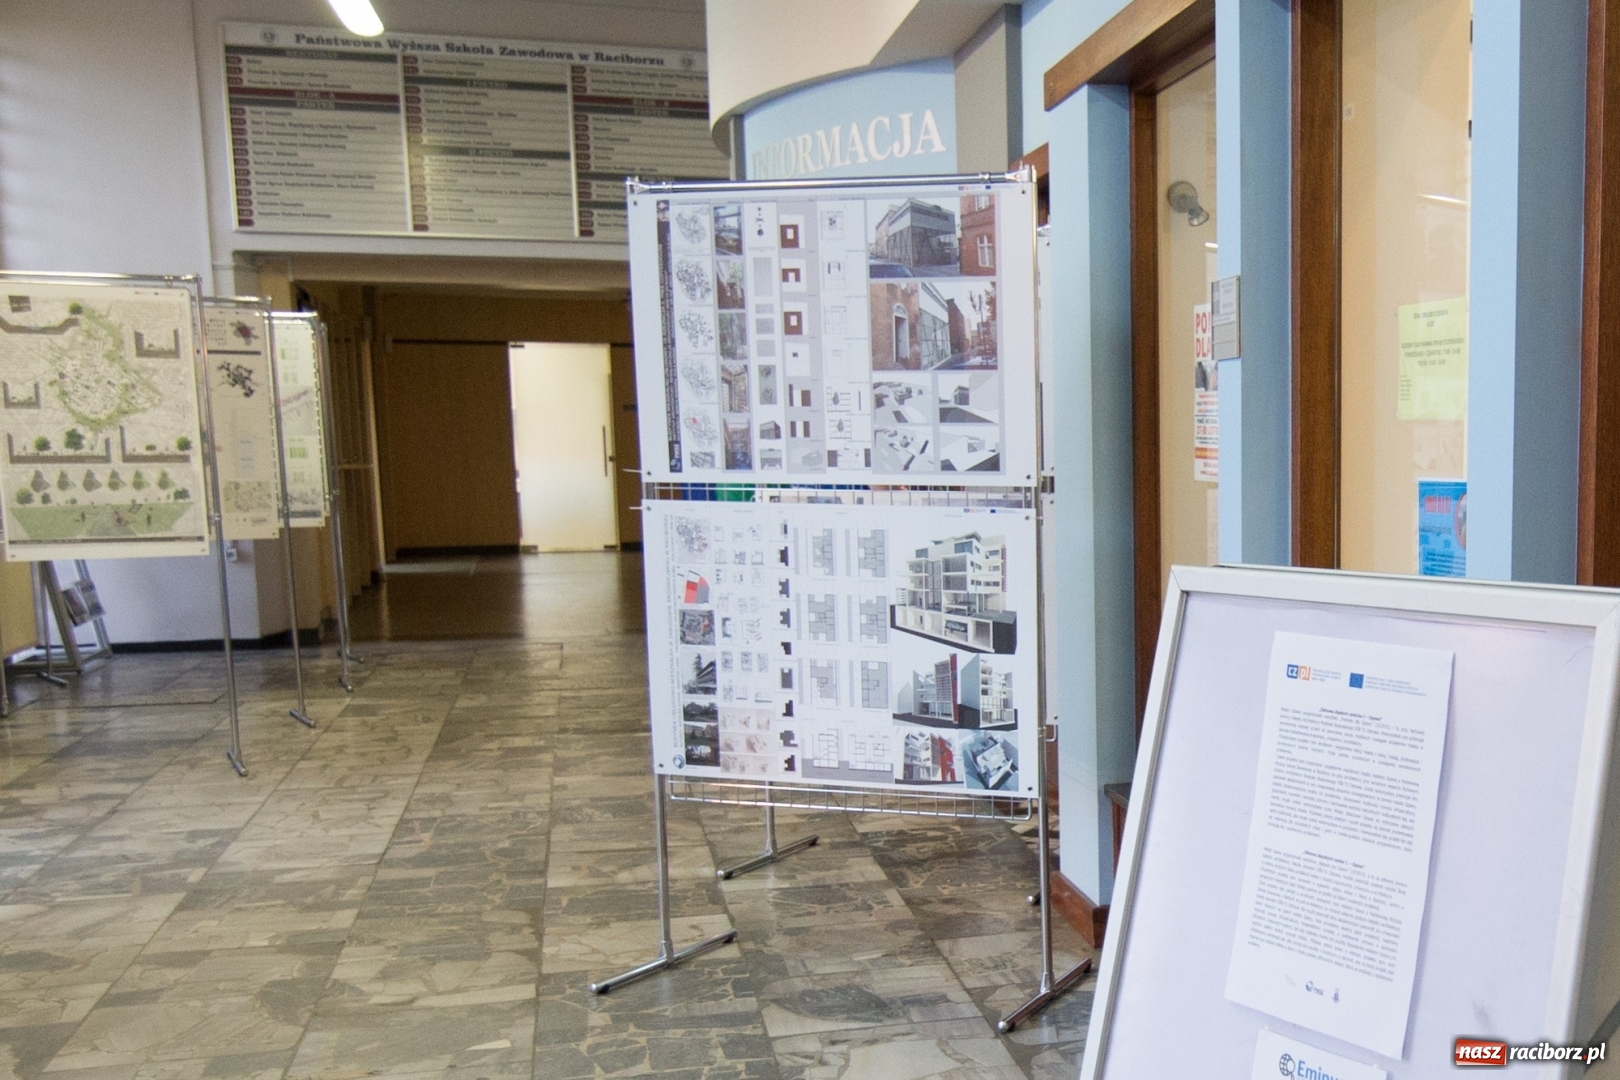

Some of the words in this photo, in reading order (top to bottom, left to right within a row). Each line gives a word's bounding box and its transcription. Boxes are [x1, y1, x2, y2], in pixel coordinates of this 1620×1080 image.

[294, 33, 383, 49] Państwowa
[387, 39, 441, 53] Wyższa
[445, 42, 495, 55] Szkoła
[499, 46, 574, 61] Zawodowa
[579, 53, 589, 61] w
[594, 52, 665, 66] Raciborzu
[752, 109, 947, 180] INFORMACJA
